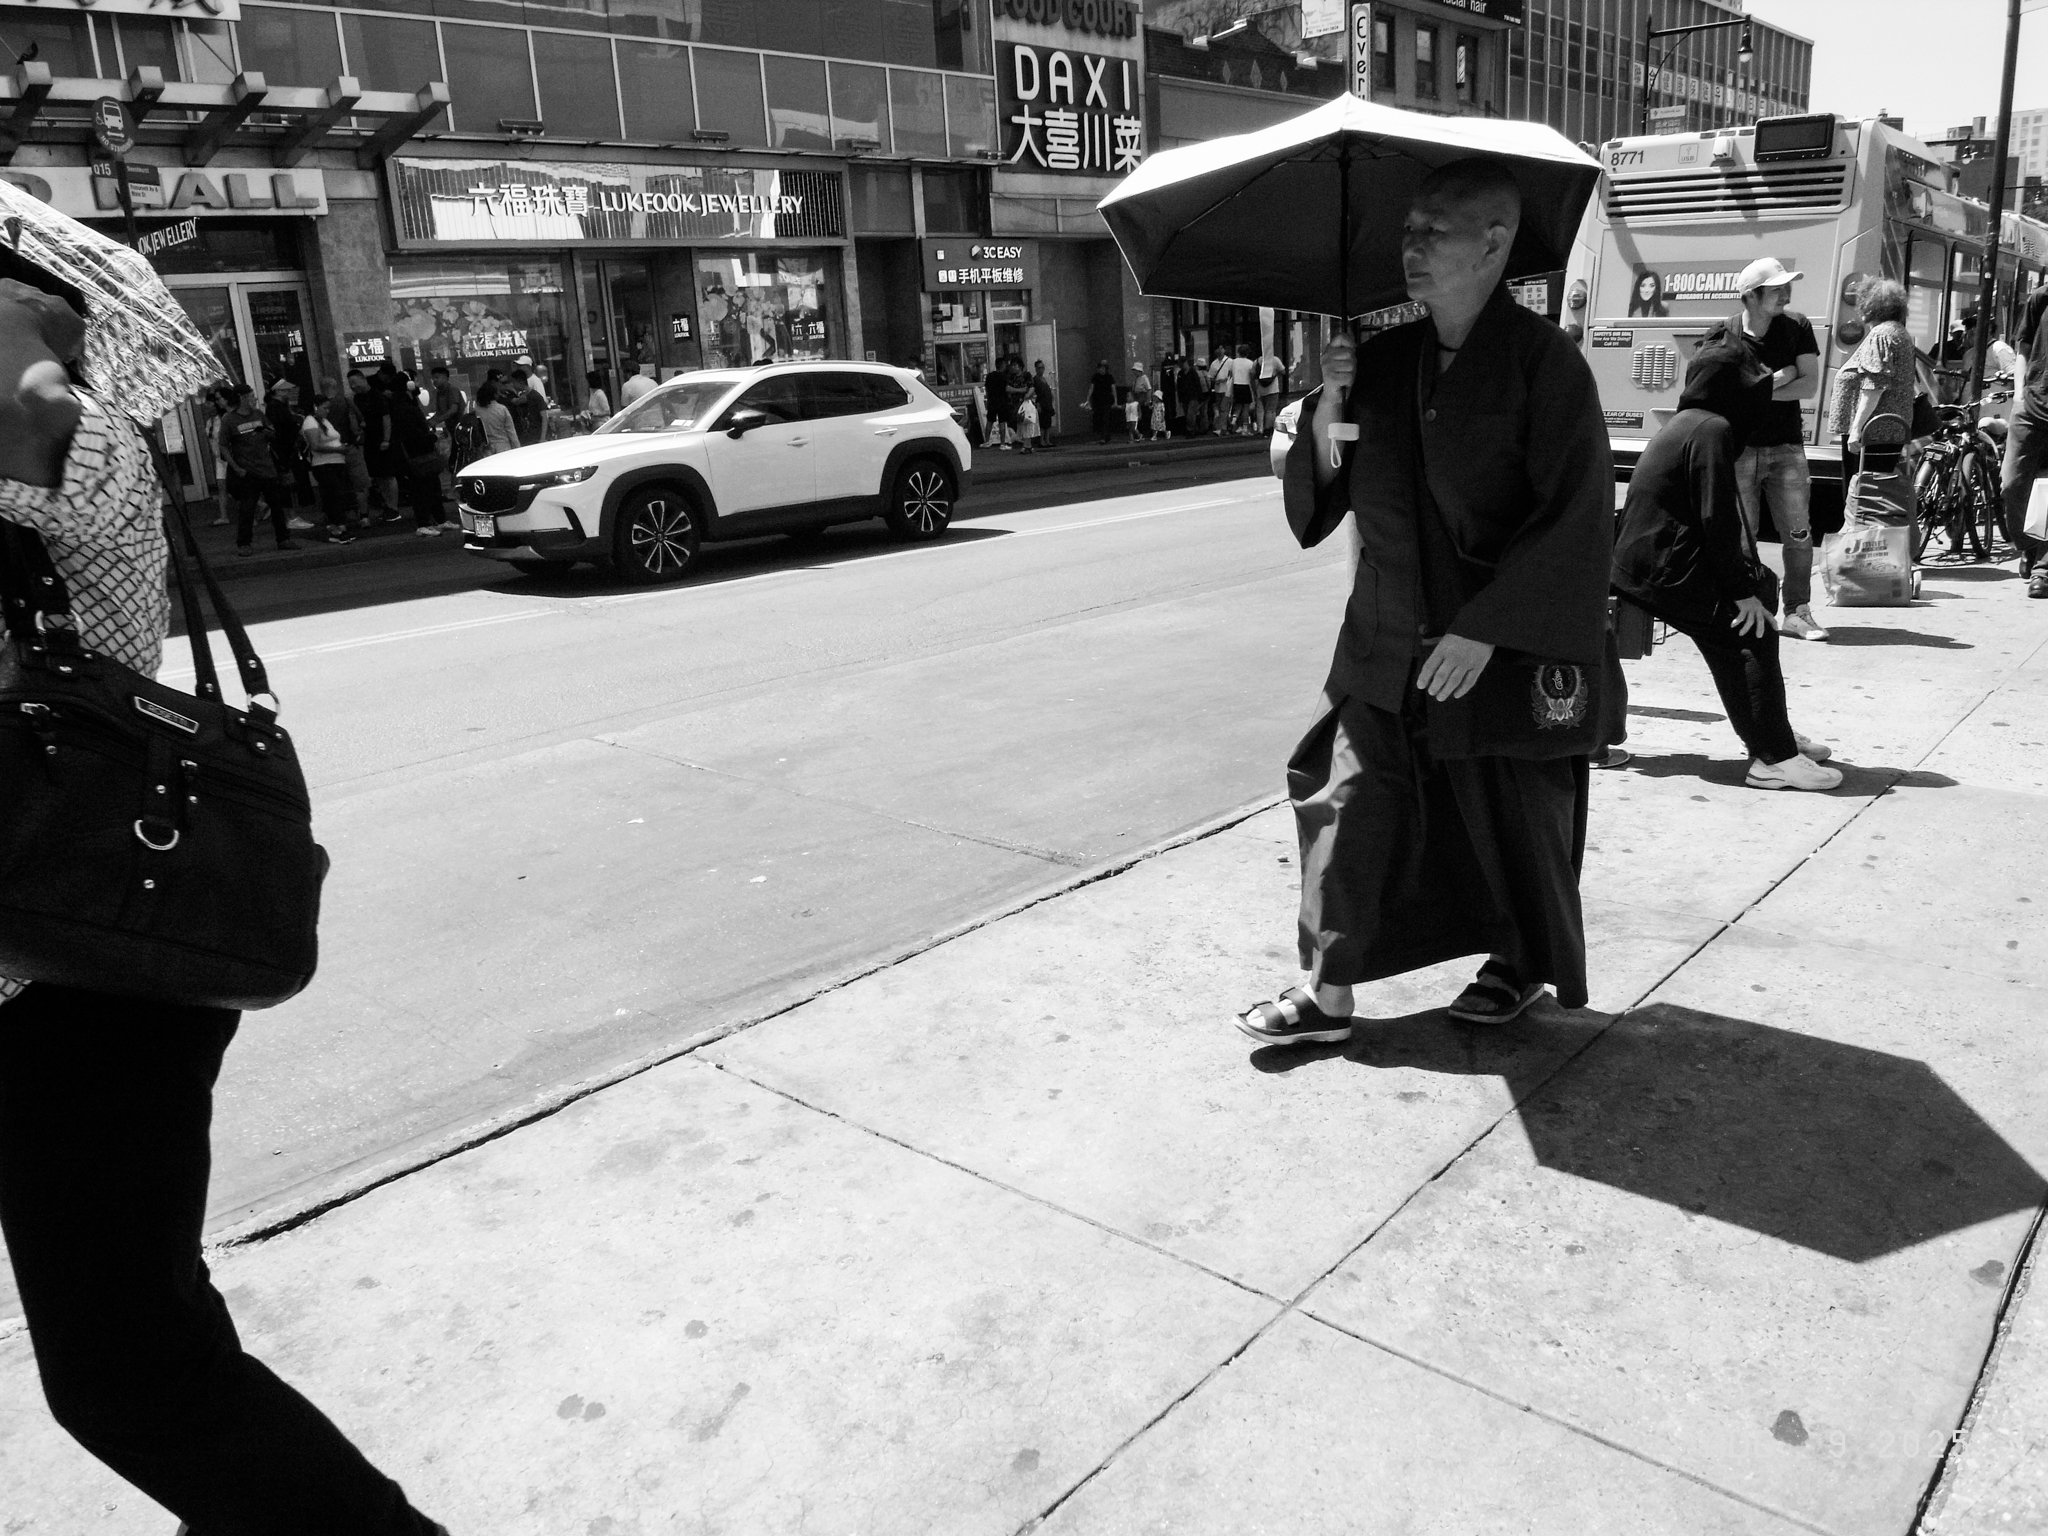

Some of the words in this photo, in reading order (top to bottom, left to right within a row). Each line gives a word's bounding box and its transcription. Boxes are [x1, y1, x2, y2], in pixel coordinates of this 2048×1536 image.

[1063, 0, 1139, 37] COURT
[1470, 0, 1487, 13] hair
[1357, 16, 1366, 100] Ever
[1014, 44, 1131, 111] DAXI
[1010, 104, 1142, 174] 大喜川菜
[93, 163, 112, 176] Q15
[1611, 150, 1644, 166] 8771
[467, 182, 588, 217] 六福珠寶
[600, 191, 697, 213] LUKFOOK
[700, 194, 803, 217] JEWELLERY
[150, 217, 197, 256] JEWELLERY
[958, 267, 1024, 284] 手机平板维修
[352, 337, 385, 356] 六福
